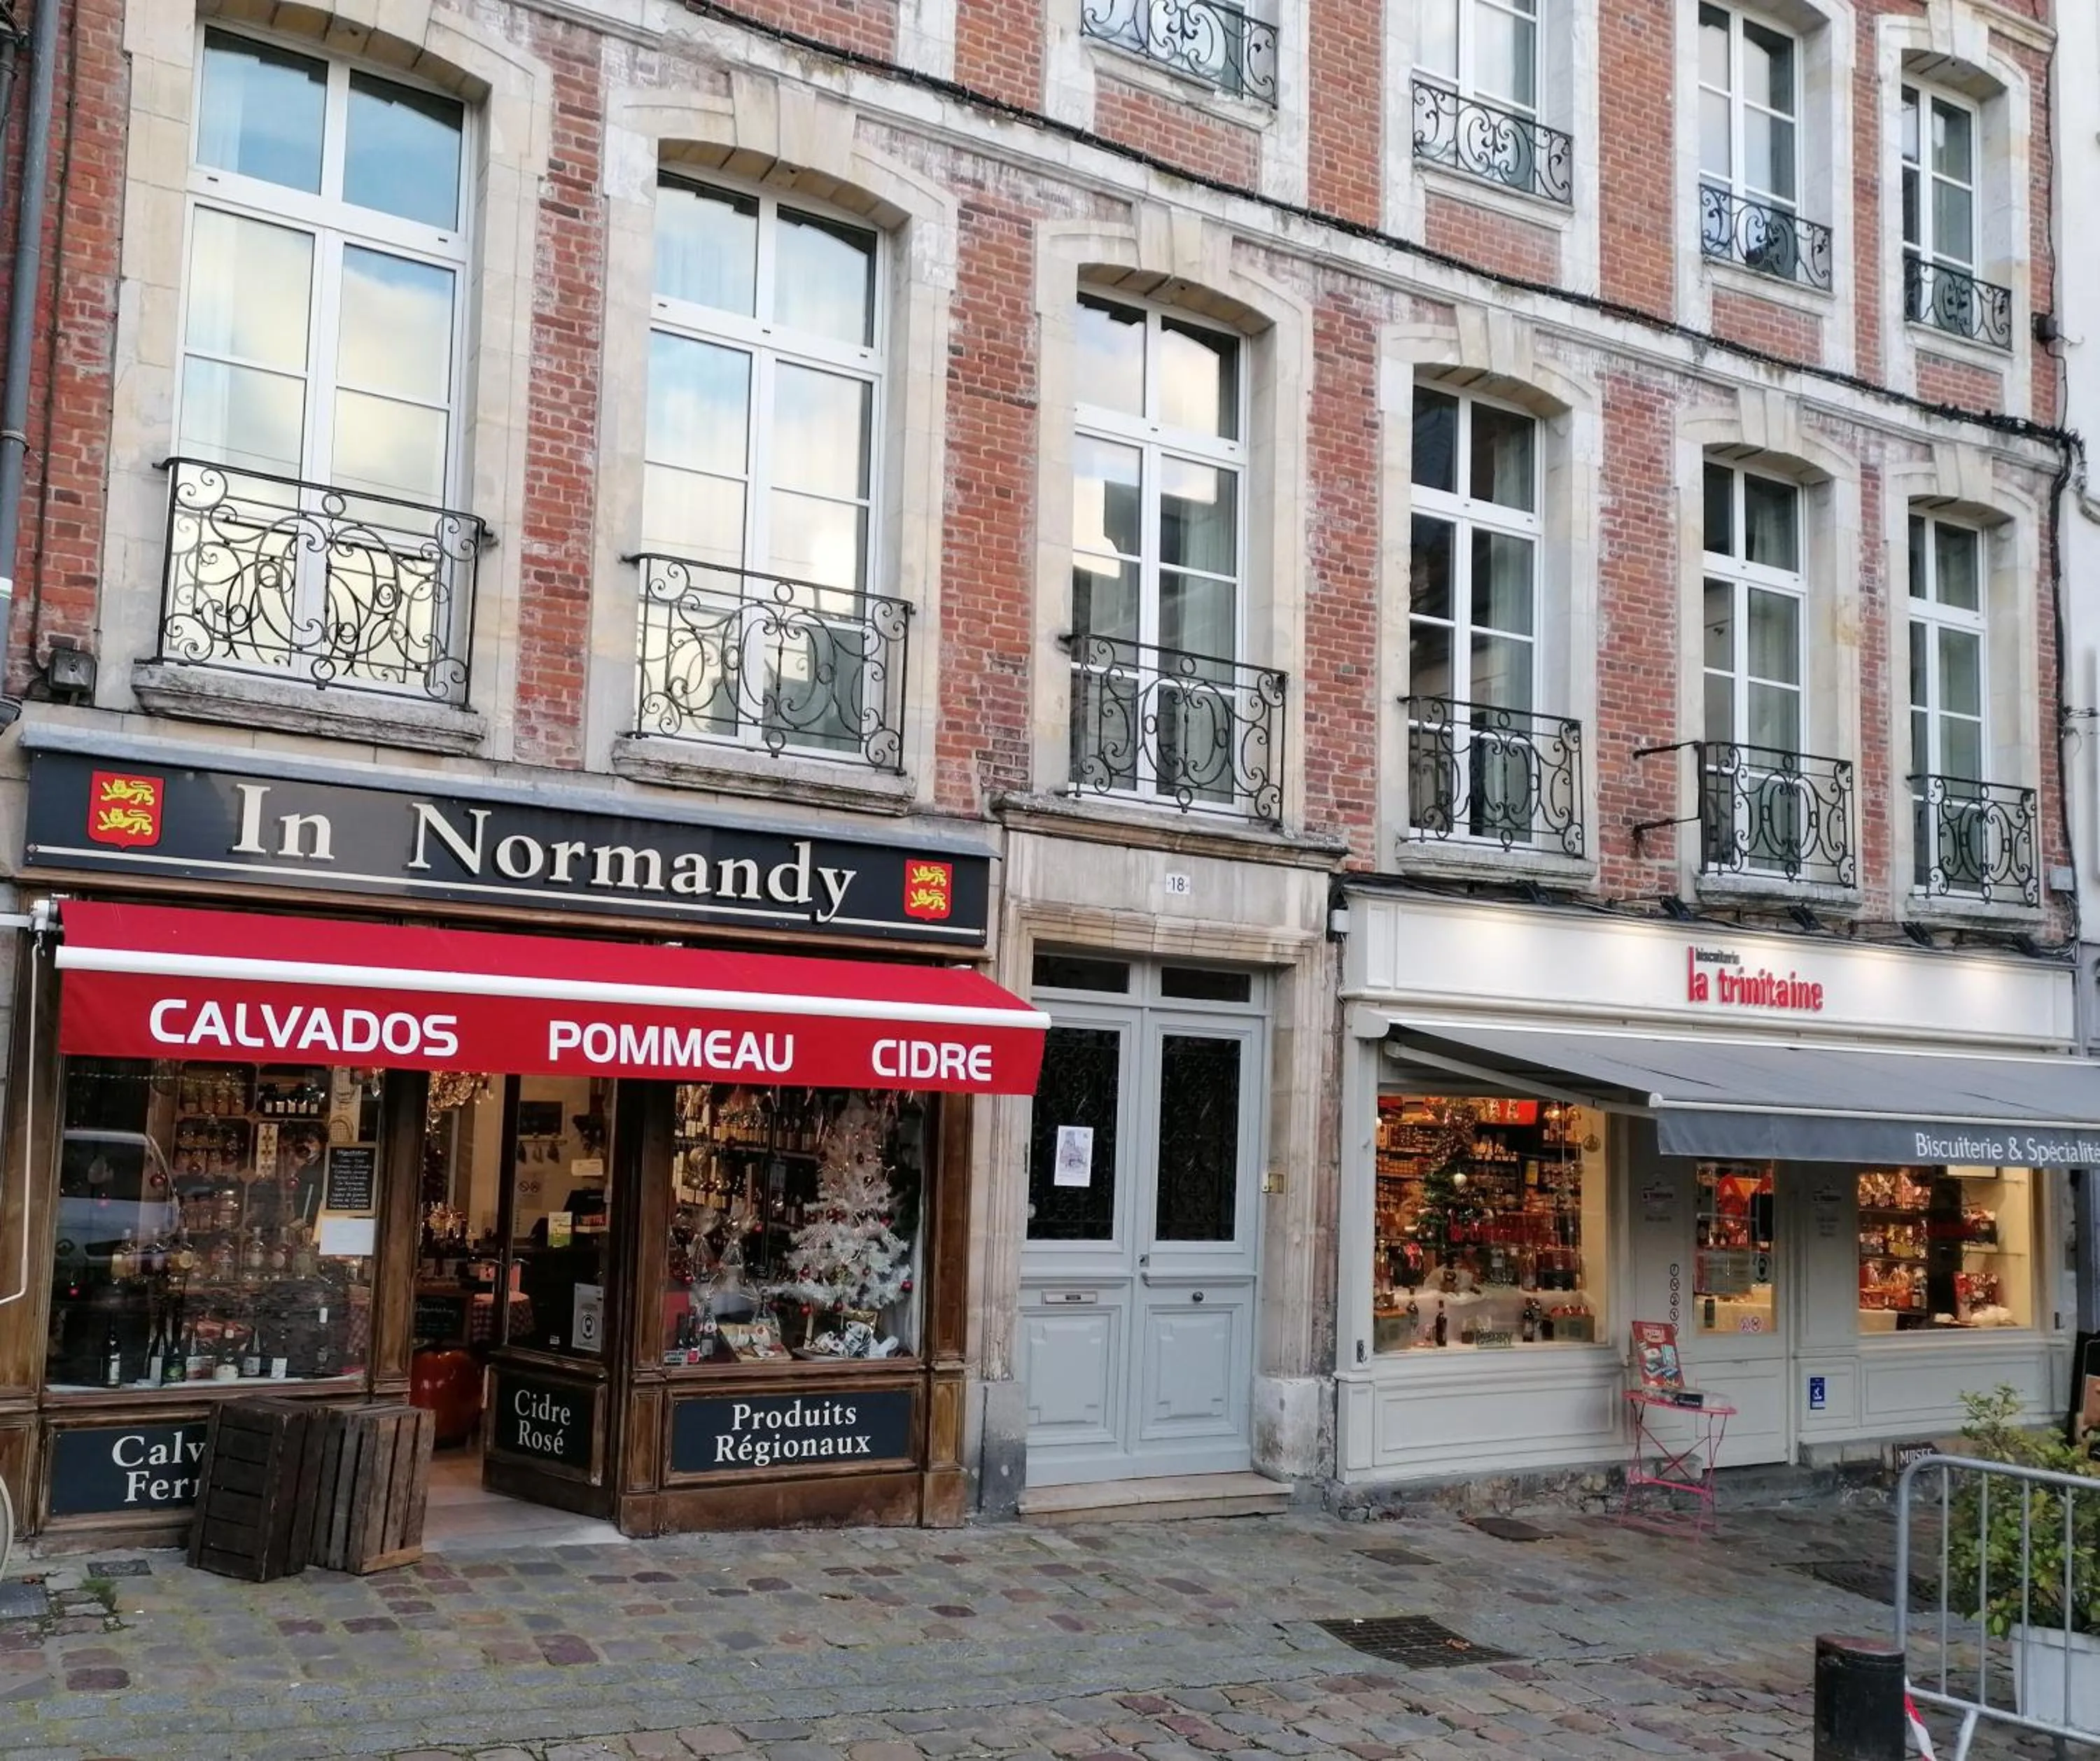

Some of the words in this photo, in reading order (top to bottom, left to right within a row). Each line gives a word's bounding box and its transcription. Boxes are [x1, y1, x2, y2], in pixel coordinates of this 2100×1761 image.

[232, 783, 335, 861] In
[407, 803, 857, 923] Normandy
[1171, 876, 1186, 892] 18
[1687, 946, 1709, 1002] la
[1718, 967, 1823, 1011] trinitaine
[149, 999, 458, 1057] CALVADOS
[548, 1019, 794, 1072] POMMEAU
[872, 1039, 993, 1081] CIDRE
[1915, 1132, 2003, 1160] Biscuiterie
[2008, 1136, 2022, 1160] &
[514, 1390, 571, 1426] Cidre
[732, 1400, 857, 1431] Produits
[518, 1419, 564, 1455] Rosé
[715, 1433, 871, 1467] Régionaux
